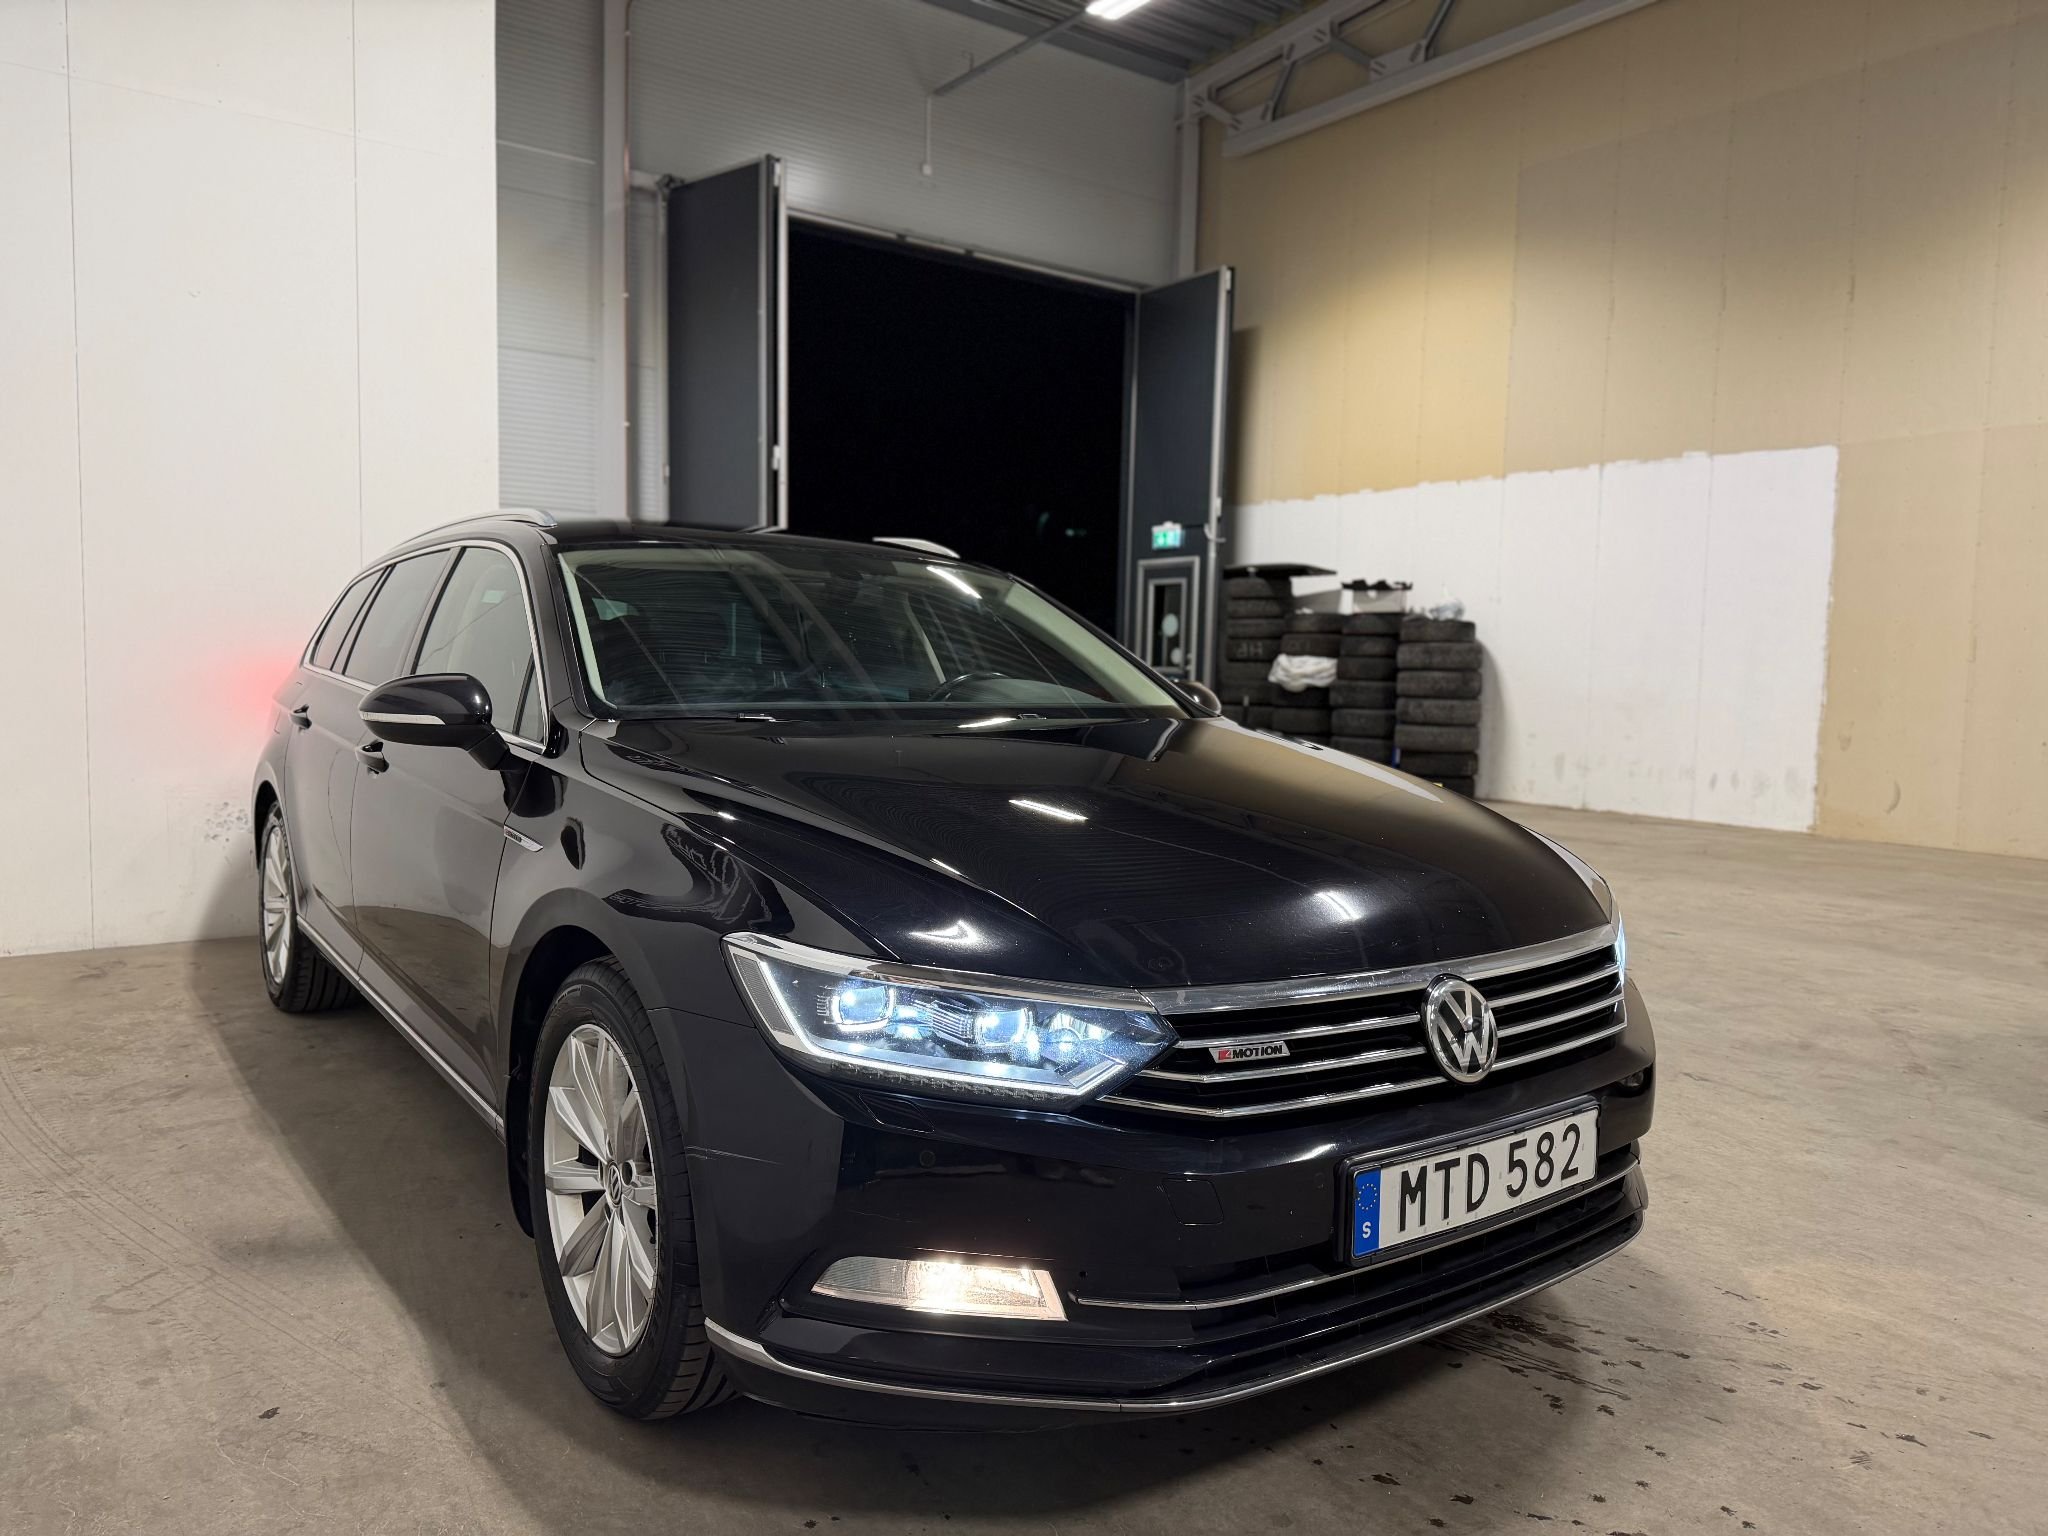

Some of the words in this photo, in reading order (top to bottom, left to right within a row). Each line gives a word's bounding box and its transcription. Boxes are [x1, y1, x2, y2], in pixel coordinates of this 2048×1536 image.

[1433, 984, 1492, 1077] VW
[1398, 1152, 1490, 1233] MTD
[1506, 1122, 1581, 1198] 582
[1362, 1221, 1372, 1239] S
